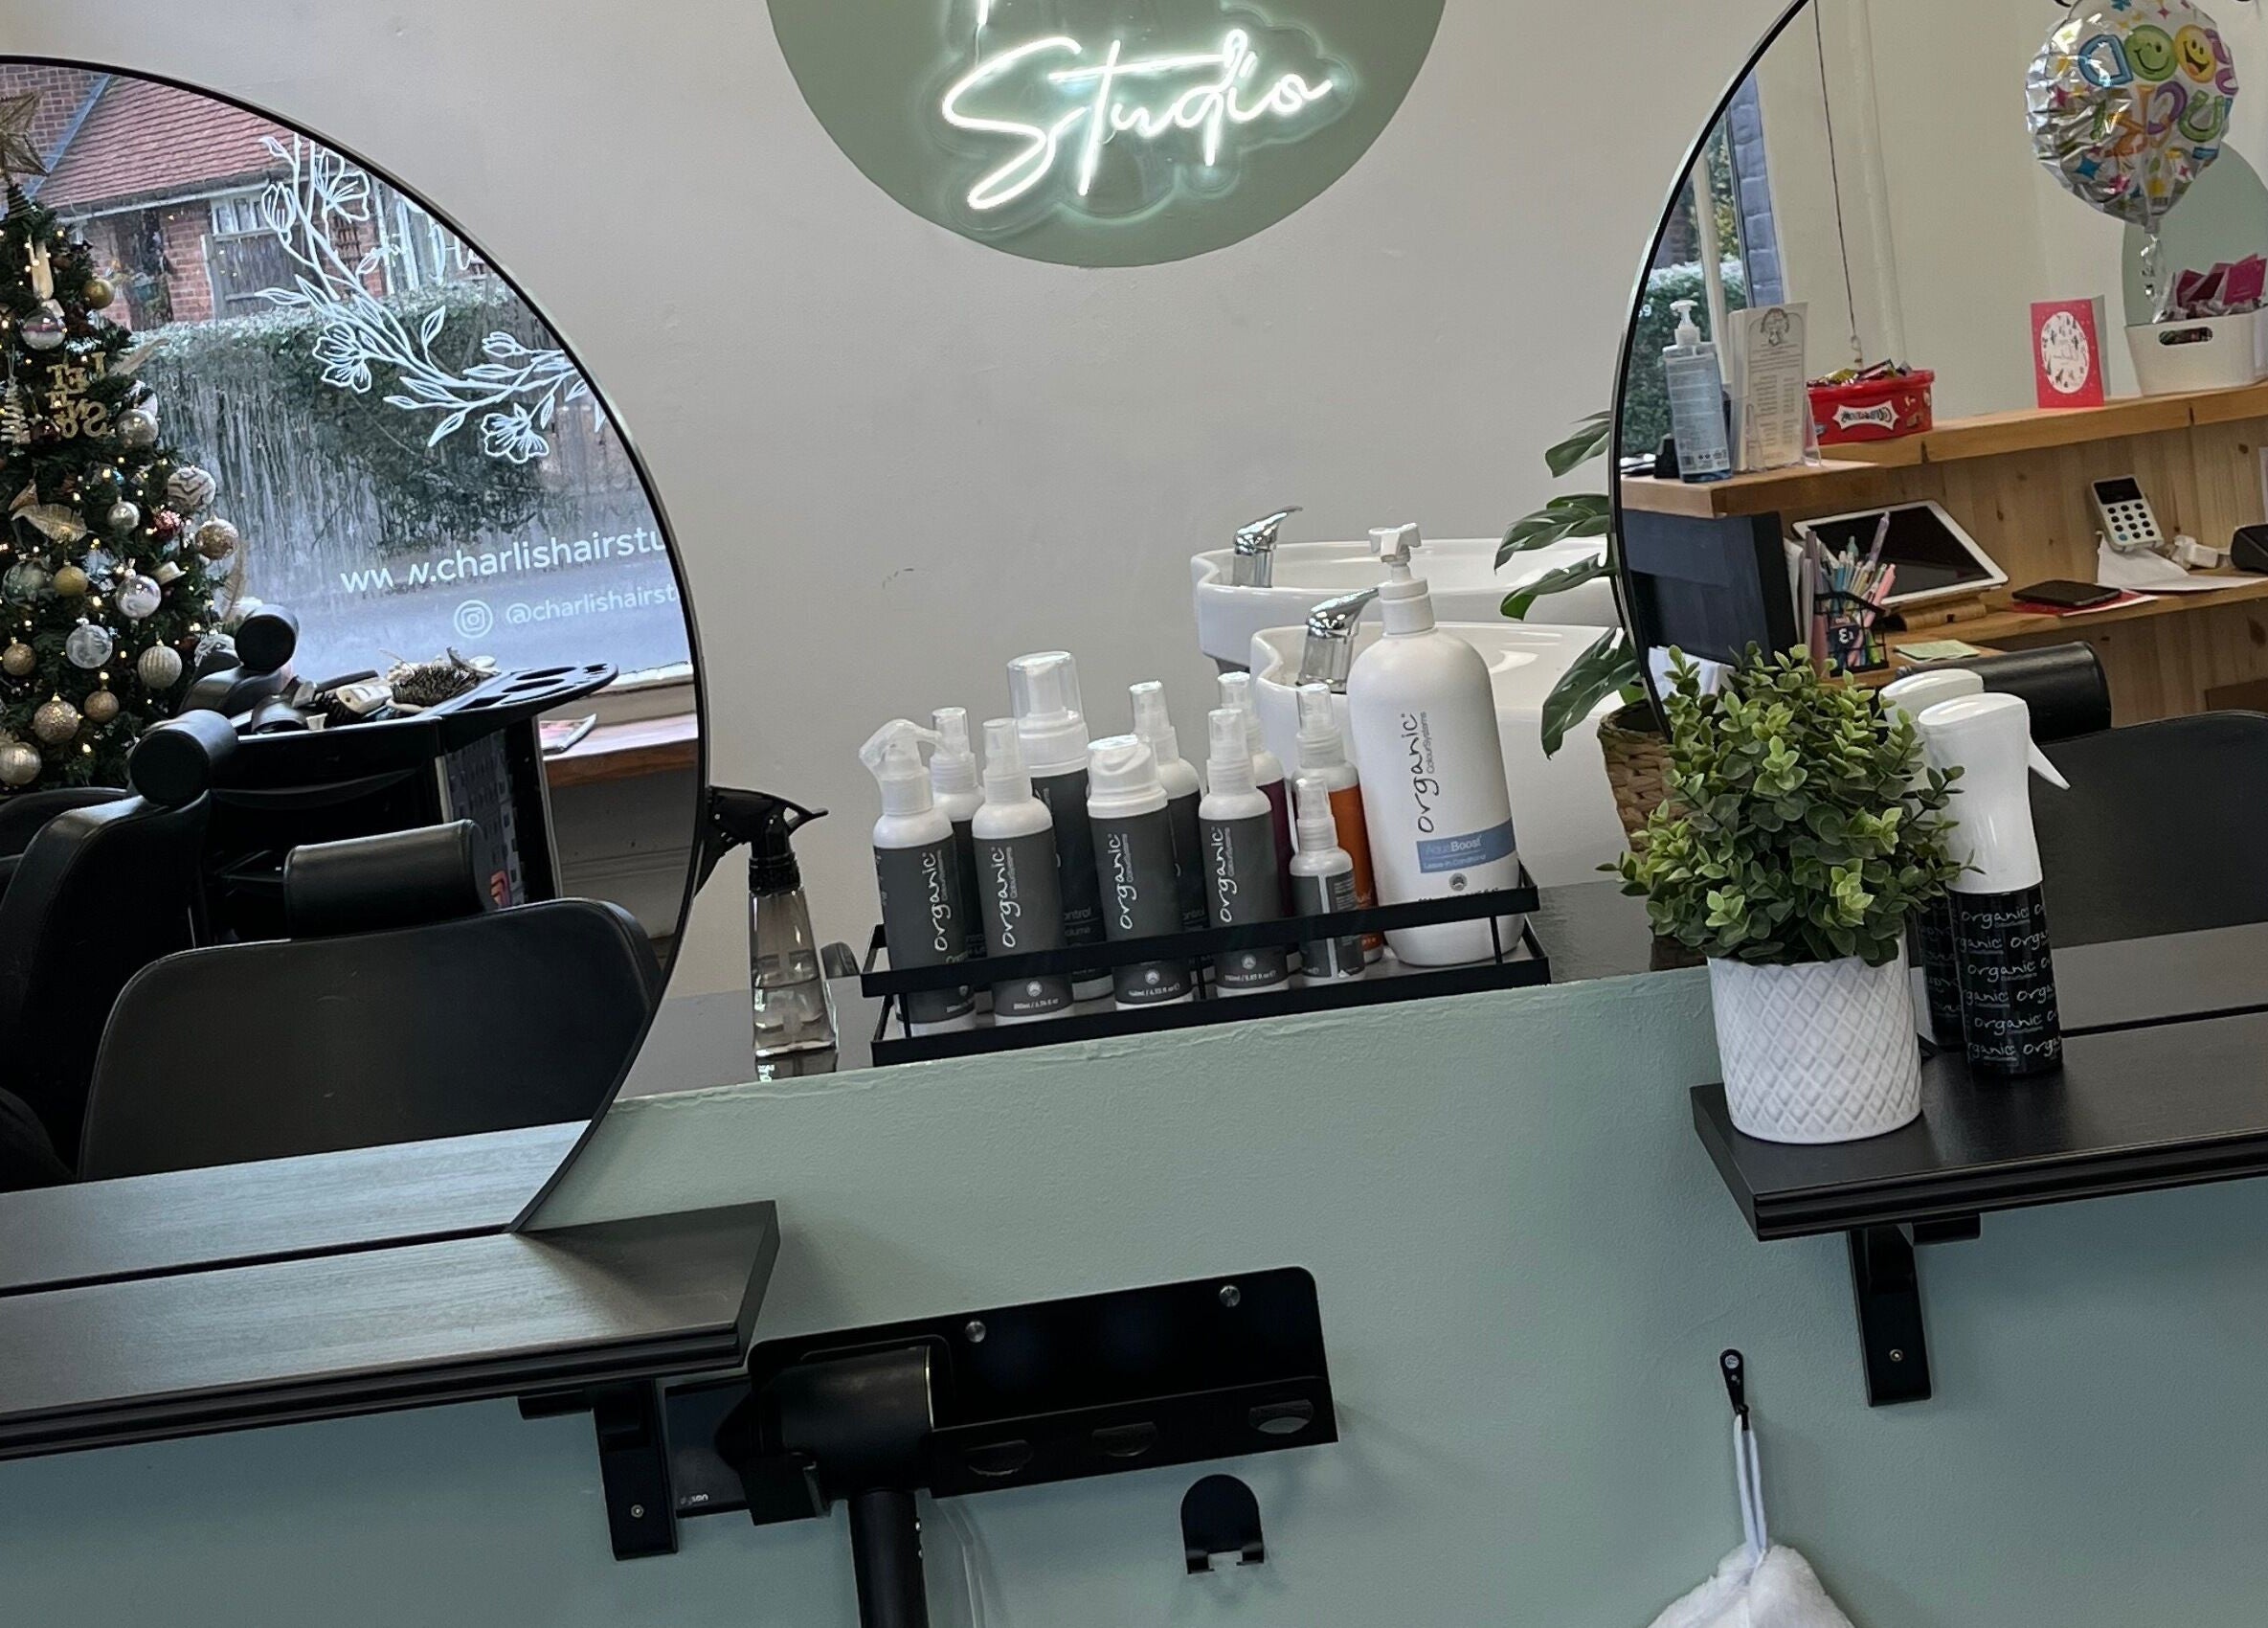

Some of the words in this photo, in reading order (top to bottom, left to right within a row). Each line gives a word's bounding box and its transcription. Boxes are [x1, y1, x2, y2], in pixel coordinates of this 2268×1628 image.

[942, 29, 1333, 210] Studio
[1401, 712, 1440, 833] organic
[921, 851, 952, 952] organic
[991, 847, 1022, 948] organic
[1108, 833, 1138, 930] organic
[1211, 826, 1238, 922] organic
[1962, 908, 2030, 929] organic
[1967, 960, 2035, 983] organic
[1974, 1013, 2042, 1036] organic
